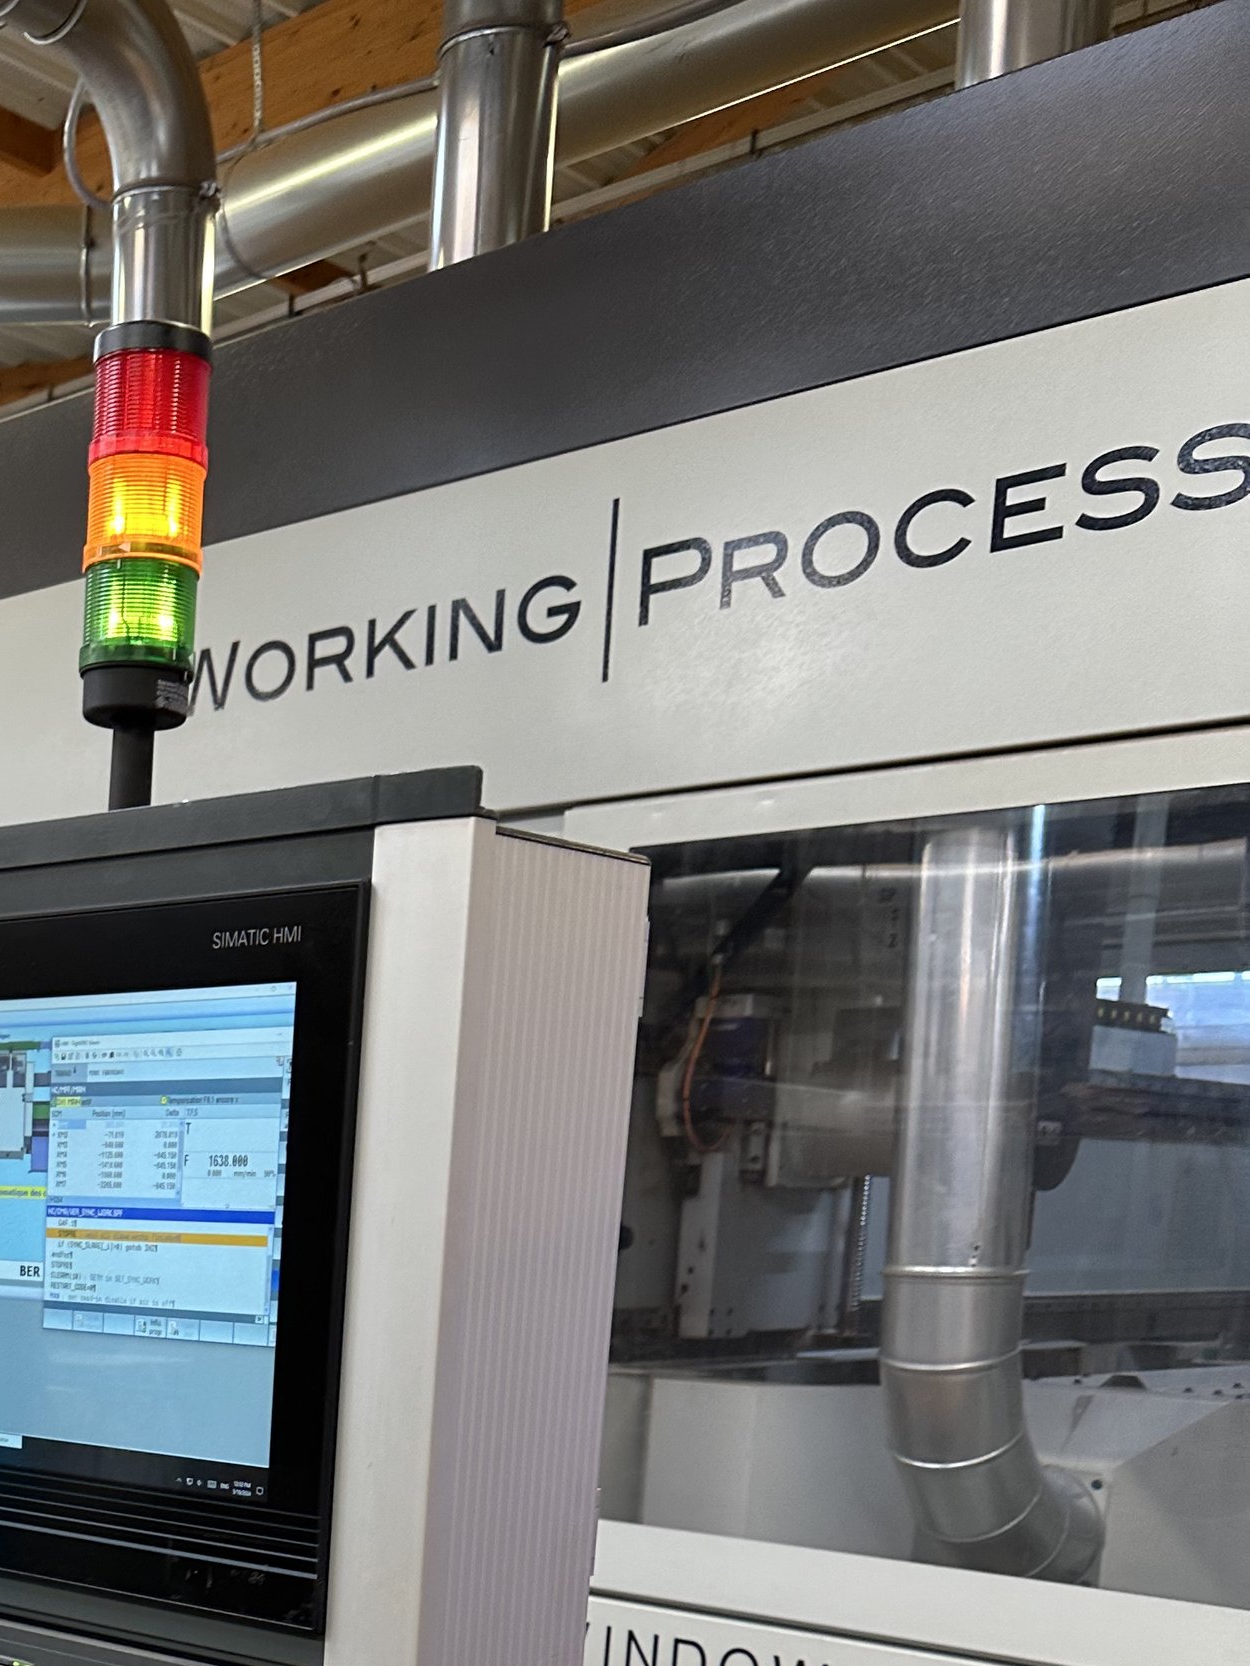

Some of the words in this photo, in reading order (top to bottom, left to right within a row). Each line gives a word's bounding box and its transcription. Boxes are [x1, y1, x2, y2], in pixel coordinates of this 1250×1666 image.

[187, 573, 581, 716] WORKING
[638, 421, 1250, 628] PROCESS
[212, 928, 270, 949] SIMATIC
[273, 925, 302, 944] HMI
[186, 1122, 192, 1135] T
[184, 1155, 190, 1167] F
[209, 1155, 249, 1168] 1638.000
[19, 1265, 41, 1278] BER
